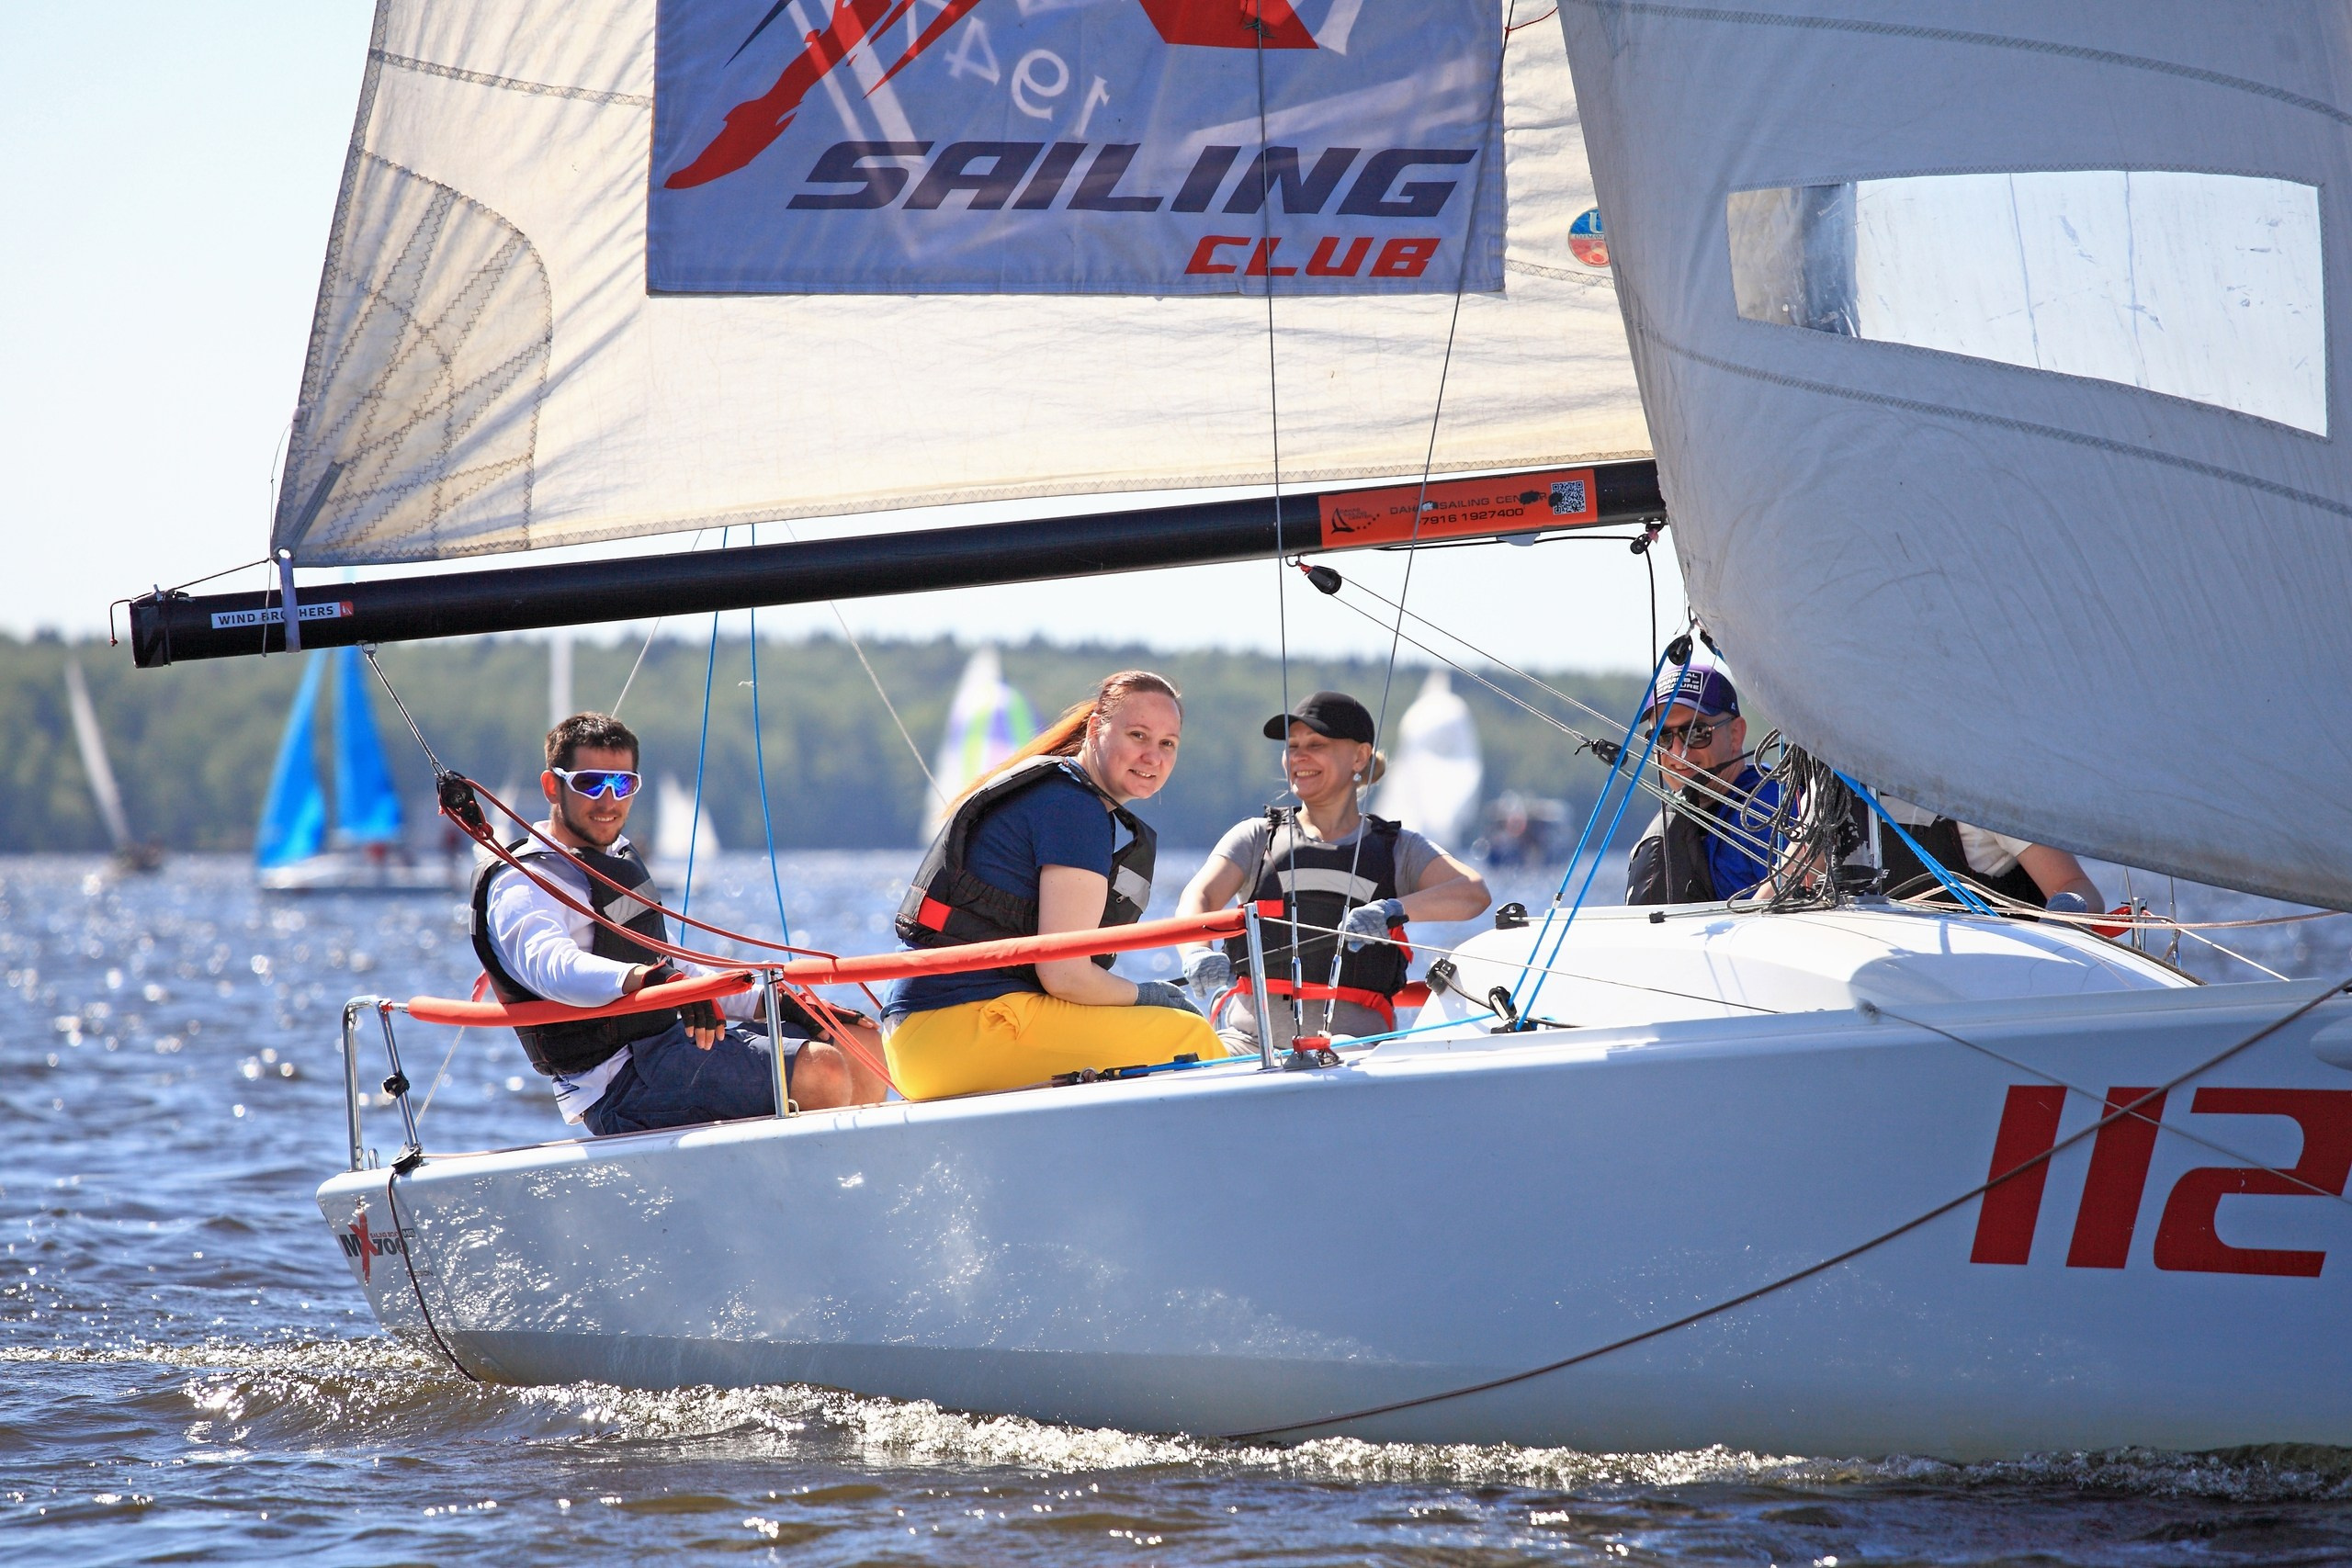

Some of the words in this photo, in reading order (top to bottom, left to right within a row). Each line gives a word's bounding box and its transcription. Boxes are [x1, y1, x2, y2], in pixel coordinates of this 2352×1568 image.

[786, 141, 1477, 217] SAILING
[1185, 235, 1441, 277] CLUB
[1440, 497, 1490, 510] SAILING
[1496, 492, 1547, 504] CENR
[1462, 508, 1524, 521] 1927400
[218, 613, 255, 626] WIND
[261, 605, 334, 623] BRHERS
[1970, 1085, 2352, 1278] 112
